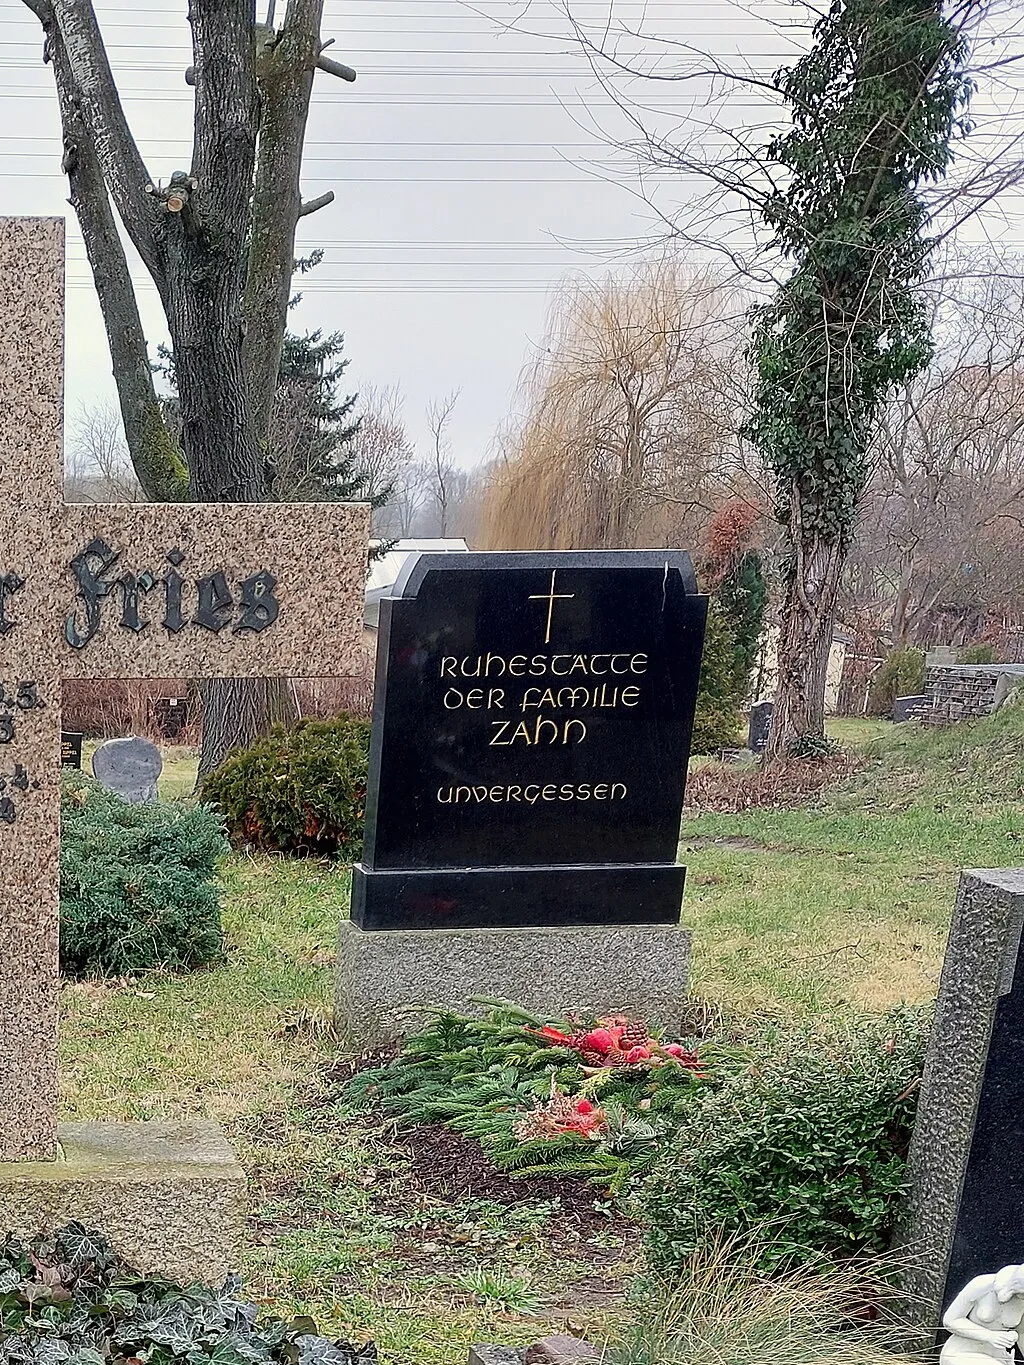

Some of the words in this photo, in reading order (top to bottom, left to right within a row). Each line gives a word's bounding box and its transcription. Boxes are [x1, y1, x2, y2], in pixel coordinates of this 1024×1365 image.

[65, 537, 279, 649] Fries
[443, 687, 505, 709] DER
[519, 685, 641, 713] FAMILIE
[489, 715, 587, 746] ZAHN
[437, 782, 627, 805] UNVERGESSEN
